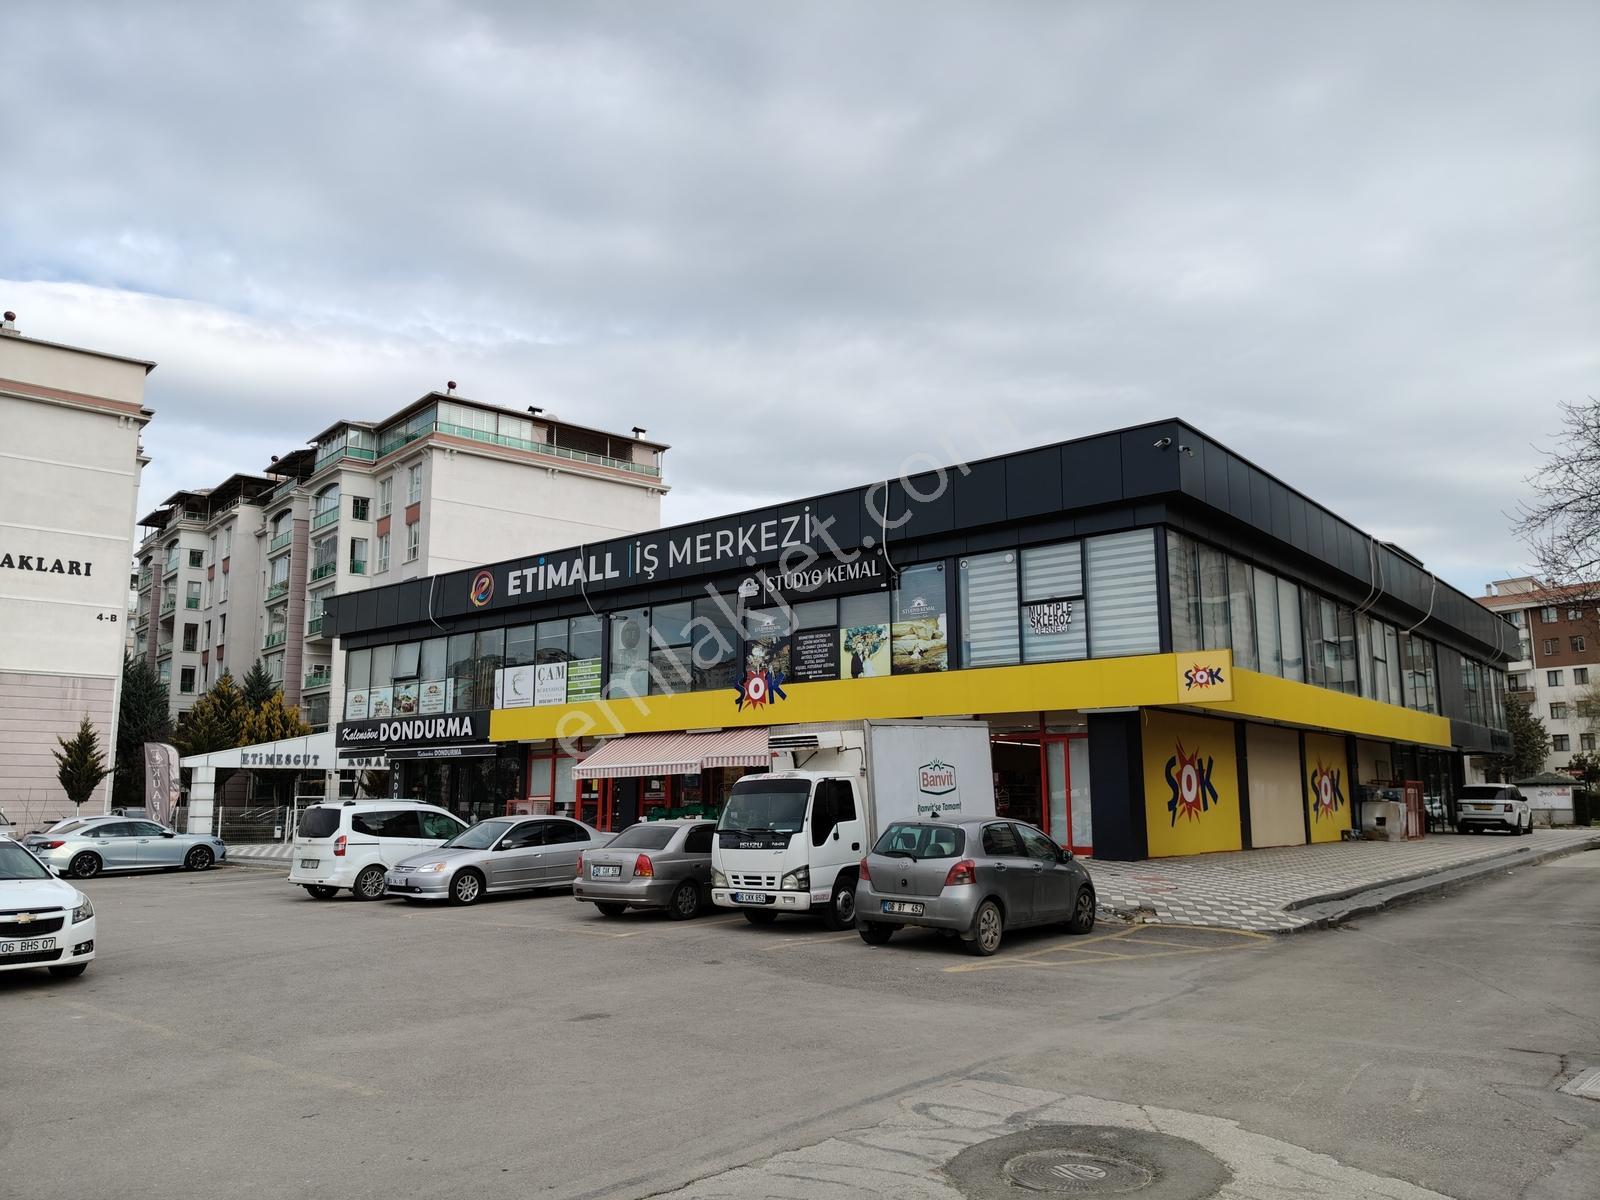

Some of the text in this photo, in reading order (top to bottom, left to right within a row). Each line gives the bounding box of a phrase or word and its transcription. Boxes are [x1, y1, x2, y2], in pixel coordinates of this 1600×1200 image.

[635, 541, 659, 580] İŞ
[669, 505, 810, 568] MERKEZİ
[827, 560, 881, 583] KEMAL
[96, 613, 117, 622] 4-B
[1028, 602, 1072, 618] MULTIPLE
[1030, 614, 1072, 628] SKLEROZ
[537, 665, 565, 686] ÇAM
[1184, 666, 1225, 691] ŞOK
[735, 668, 787, 712] ŞOK
[380, 716, 473, 742] DONDURMA
[921, 770, 954, 788] Banvit
[1165, 755, 1218, 827] ŞOK
[1311, 768, 1344, 823] ŞOK
[739, 841, 763, 849] ISUZU
[1, 939, 54, 953] 06 BHS 07
